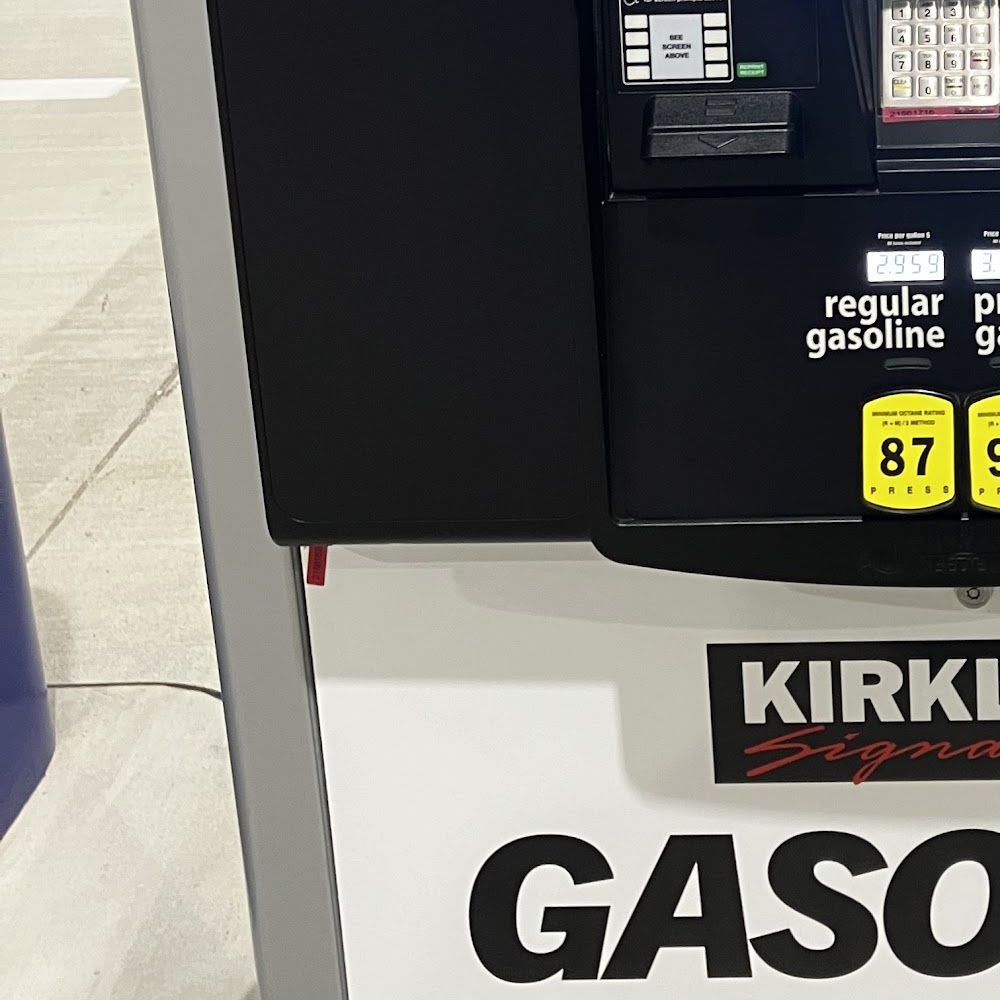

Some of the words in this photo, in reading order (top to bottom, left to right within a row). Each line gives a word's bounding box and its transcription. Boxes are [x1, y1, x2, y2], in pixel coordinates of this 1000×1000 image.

[876, 253, 940, 275] 2.959
[826, 286, 944, 327] regular
[806, 317, 944, 358] gasoline
[881, 437, 934, 476] 87
